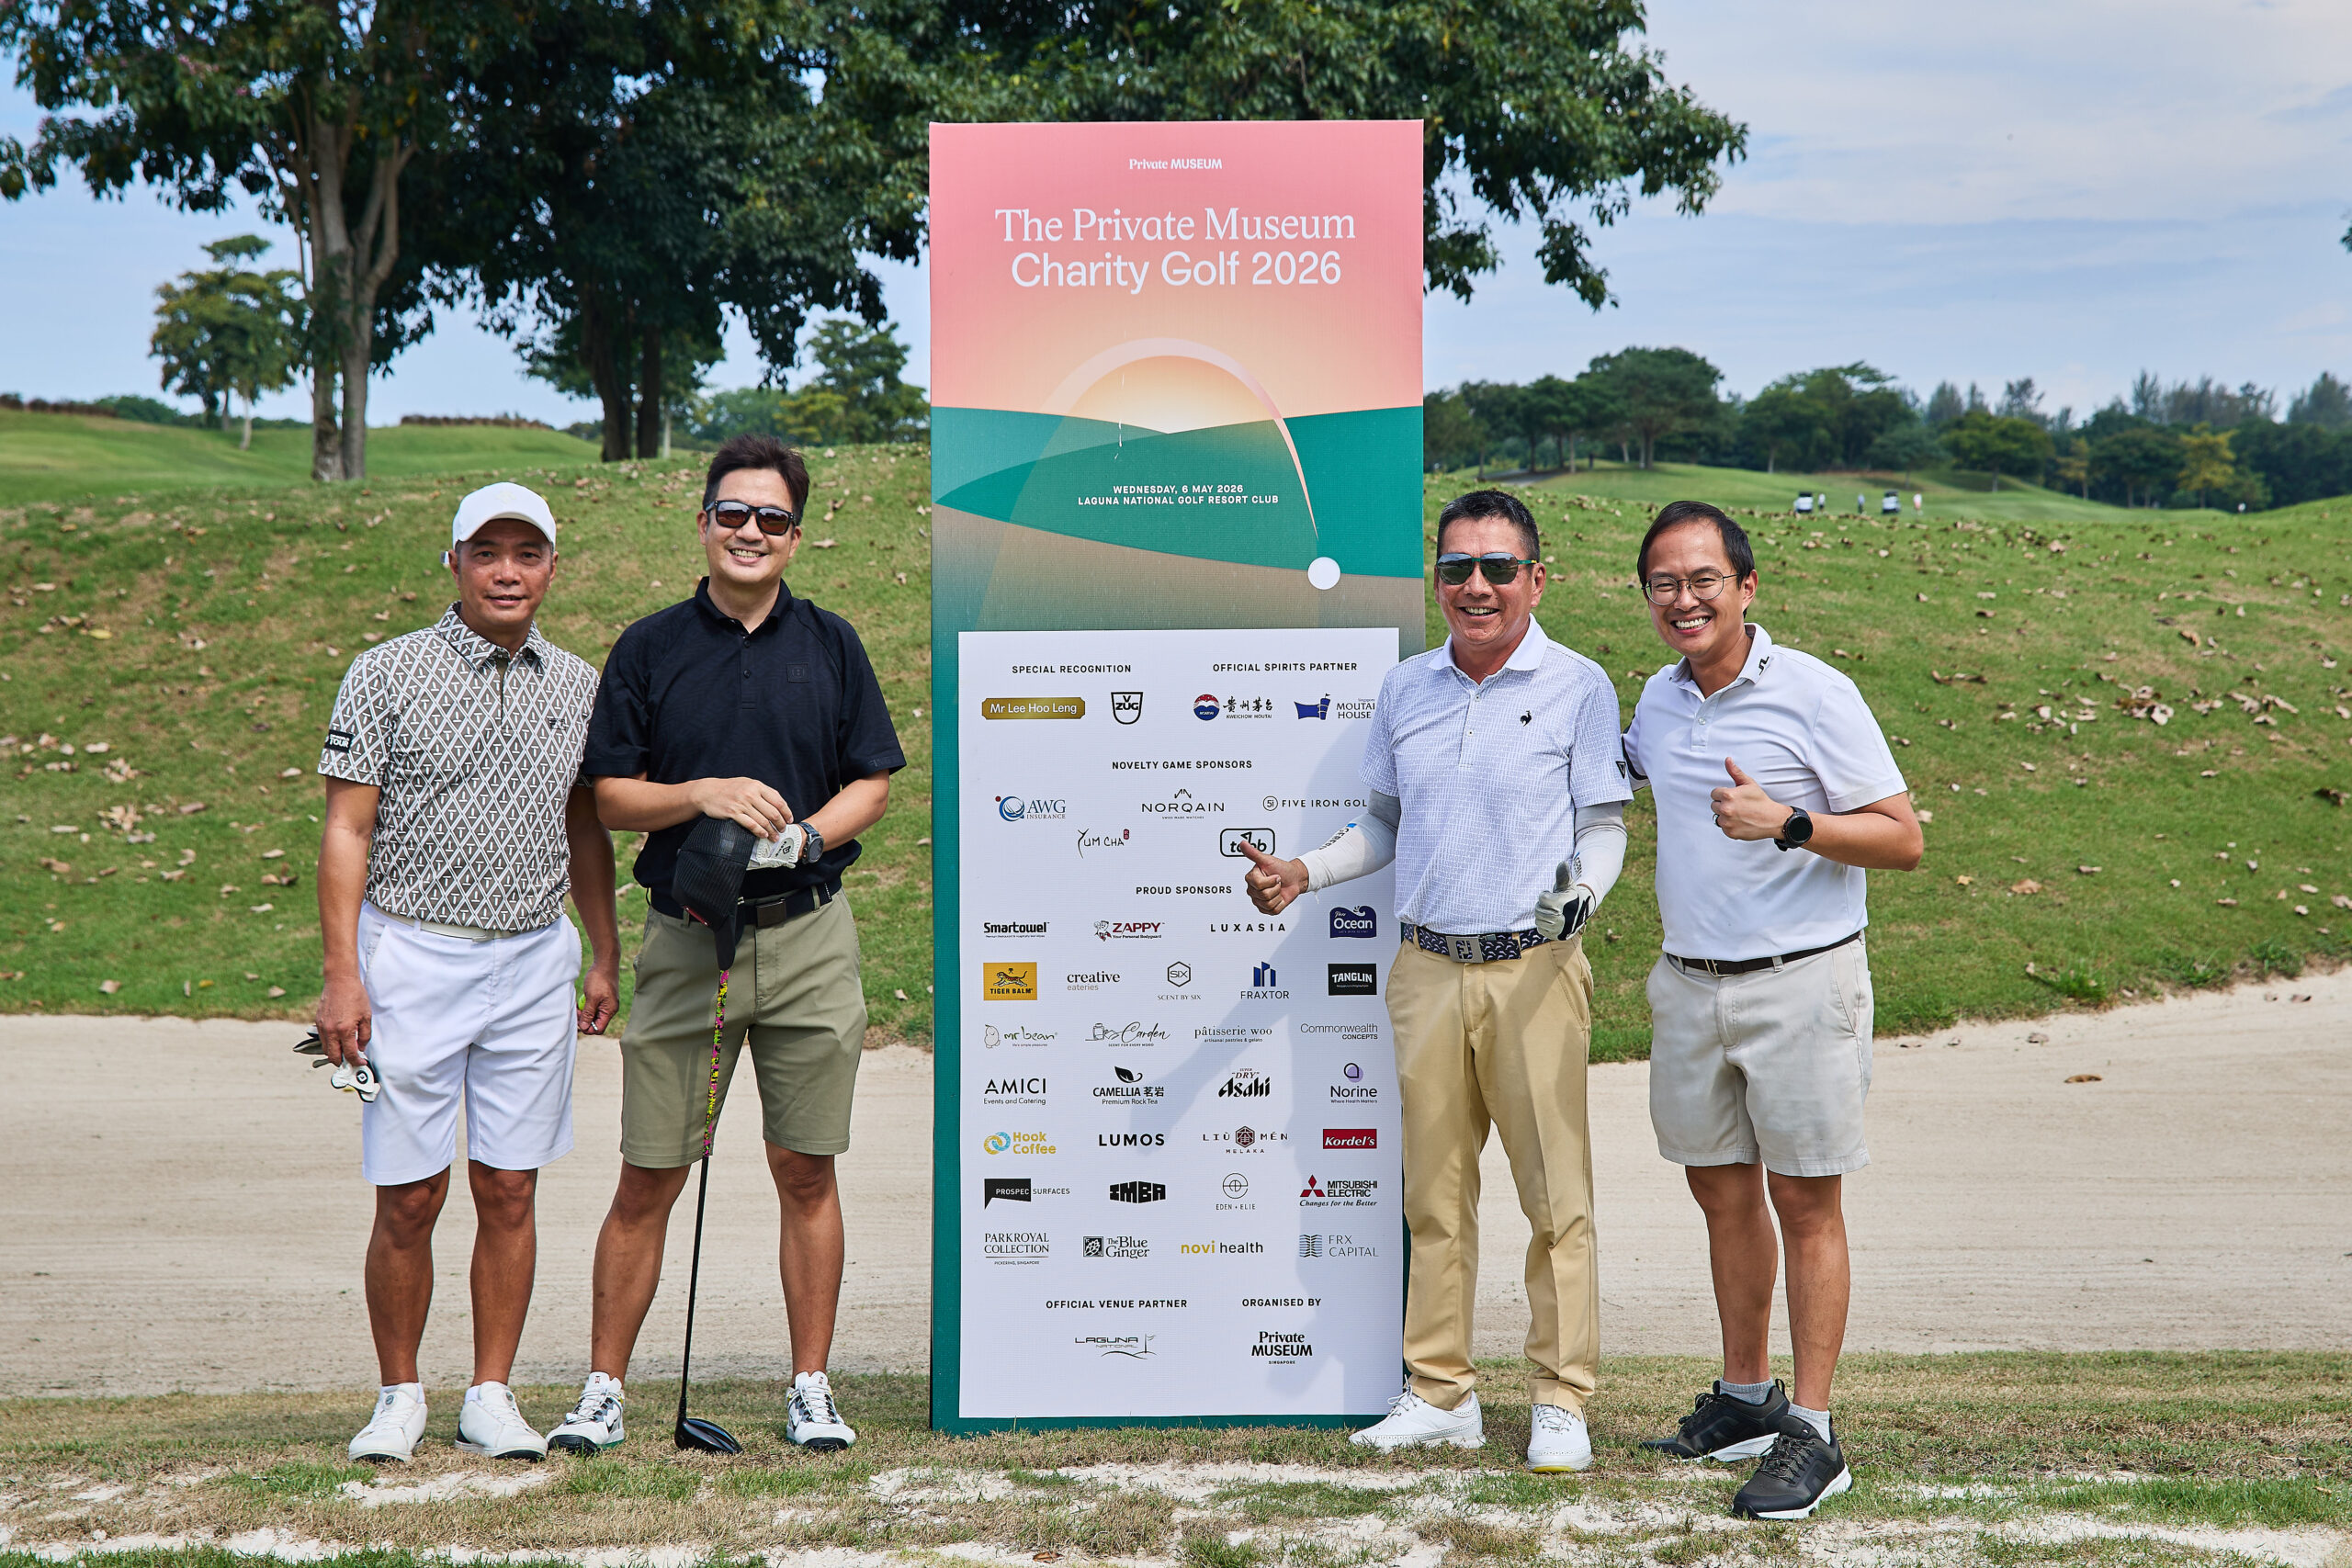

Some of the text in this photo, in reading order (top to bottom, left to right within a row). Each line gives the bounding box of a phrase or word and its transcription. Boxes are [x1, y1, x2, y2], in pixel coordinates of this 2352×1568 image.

[1129, 159, 1222, 170] Private MUSEUM
[995, 208, 1355, 241] The Private Museum
[1012, 252, 1341, 294] Charity Golf 2026
[1114, 486, 1177, 494] WEDNESDAY,
[1078, 497, 1119, 505] LAGUNA
[1012, 665, 1056, 673] SPECIAL
[990, 703, 1077, 714] Mr Lee Hoo Leng
[330, 737, 349, 748] TOUR
[1113, 761, 1159, 770] NOVELTY
[1196, 761, 1252, 769] SPONSORS
[1027, 799, 1066, 813] AWG
[1142, 803, 1224, 813] NORQAIN
[1113, 923, 1160, 933] ZAPPY
[1211, 923, 1285, 931] LUXASIA
[1334, 918, 1373, 929] Ocean
[1067, 971, 1120, 983] creative
[1332, 973, 1372, 983] TANGLIN
[1021, 1026, 1055, 1040] bean
[1194, 1025, 1246, 1038] pâtisserie
[1300, 1023, 1378, 1033] Commonwealth
[985, 1078, 1046, 1094] AMICI
[1218, 1077, 1270, 1098] Asahi
[1330, 1086, 1377, 1097] Norine
[1093, 1088, 1140, 1097] CAMELLIA
[1144, 1087, 1164, 1097] 茗岩
[1013, 1132, 1046, 1142] Hook
[1099, 1134, 1165, 1146] LUMOS
[1012, 1144, 1056, 1155] Coffee
[1328, 1180, 1377, 1189] MITSUBISHI
[985, 1233, 1049, 1242] PARKROYAL
[1119, 1236, 1148, 1247] Blue
[1329, 1235, 1352, 1244] FRX
[984, 1244, 1049, 1254] COLLECTION
[1105, 1246, 1149, 1258] Ginger
[1181, 1240, 1263, 1254] novi health
[1329, 1247, 1379, 1257] CAPITAL
[1046, 1300, 1187, 1309] OFFICIAL VENUE PARTNER
[1242, 1299, 1304, 1307] ORGANISED
[1259, 1331, 1305, 1343] Private
[1251, 1345, 1312, 1356] MUSEUM
